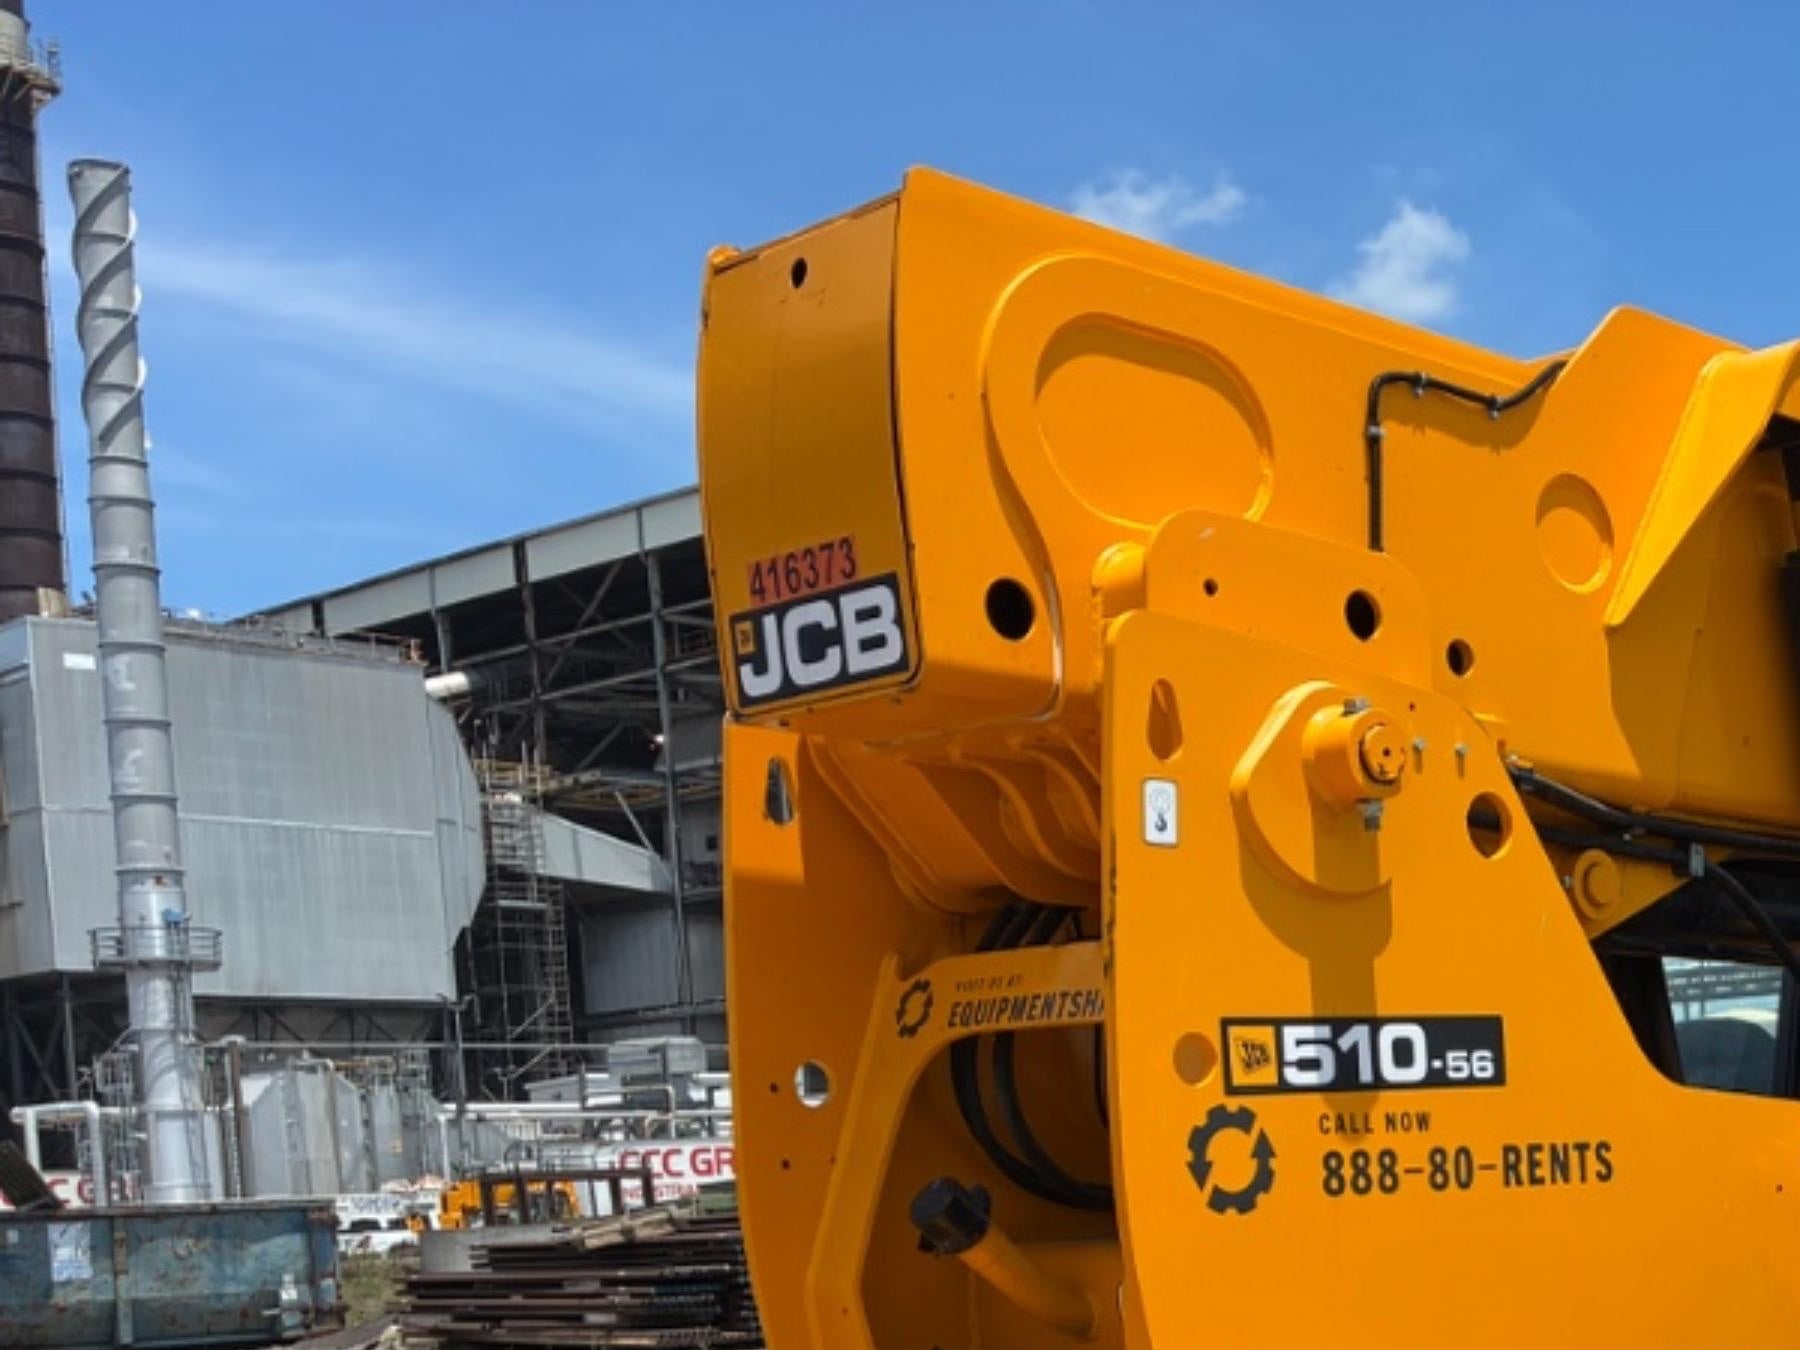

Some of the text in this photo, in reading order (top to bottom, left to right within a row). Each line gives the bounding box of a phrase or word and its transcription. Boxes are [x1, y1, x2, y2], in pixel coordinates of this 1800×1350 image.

[750, 536, 856, 601] 416373
[740, 584, 903, 697] JCB
[1281, 1022, 1495, 1086] 510-56
[1318, 1111, 1431, 1135] CALL NOW
[1322, 1141, 1614, 1197] 888-80-RENTS
